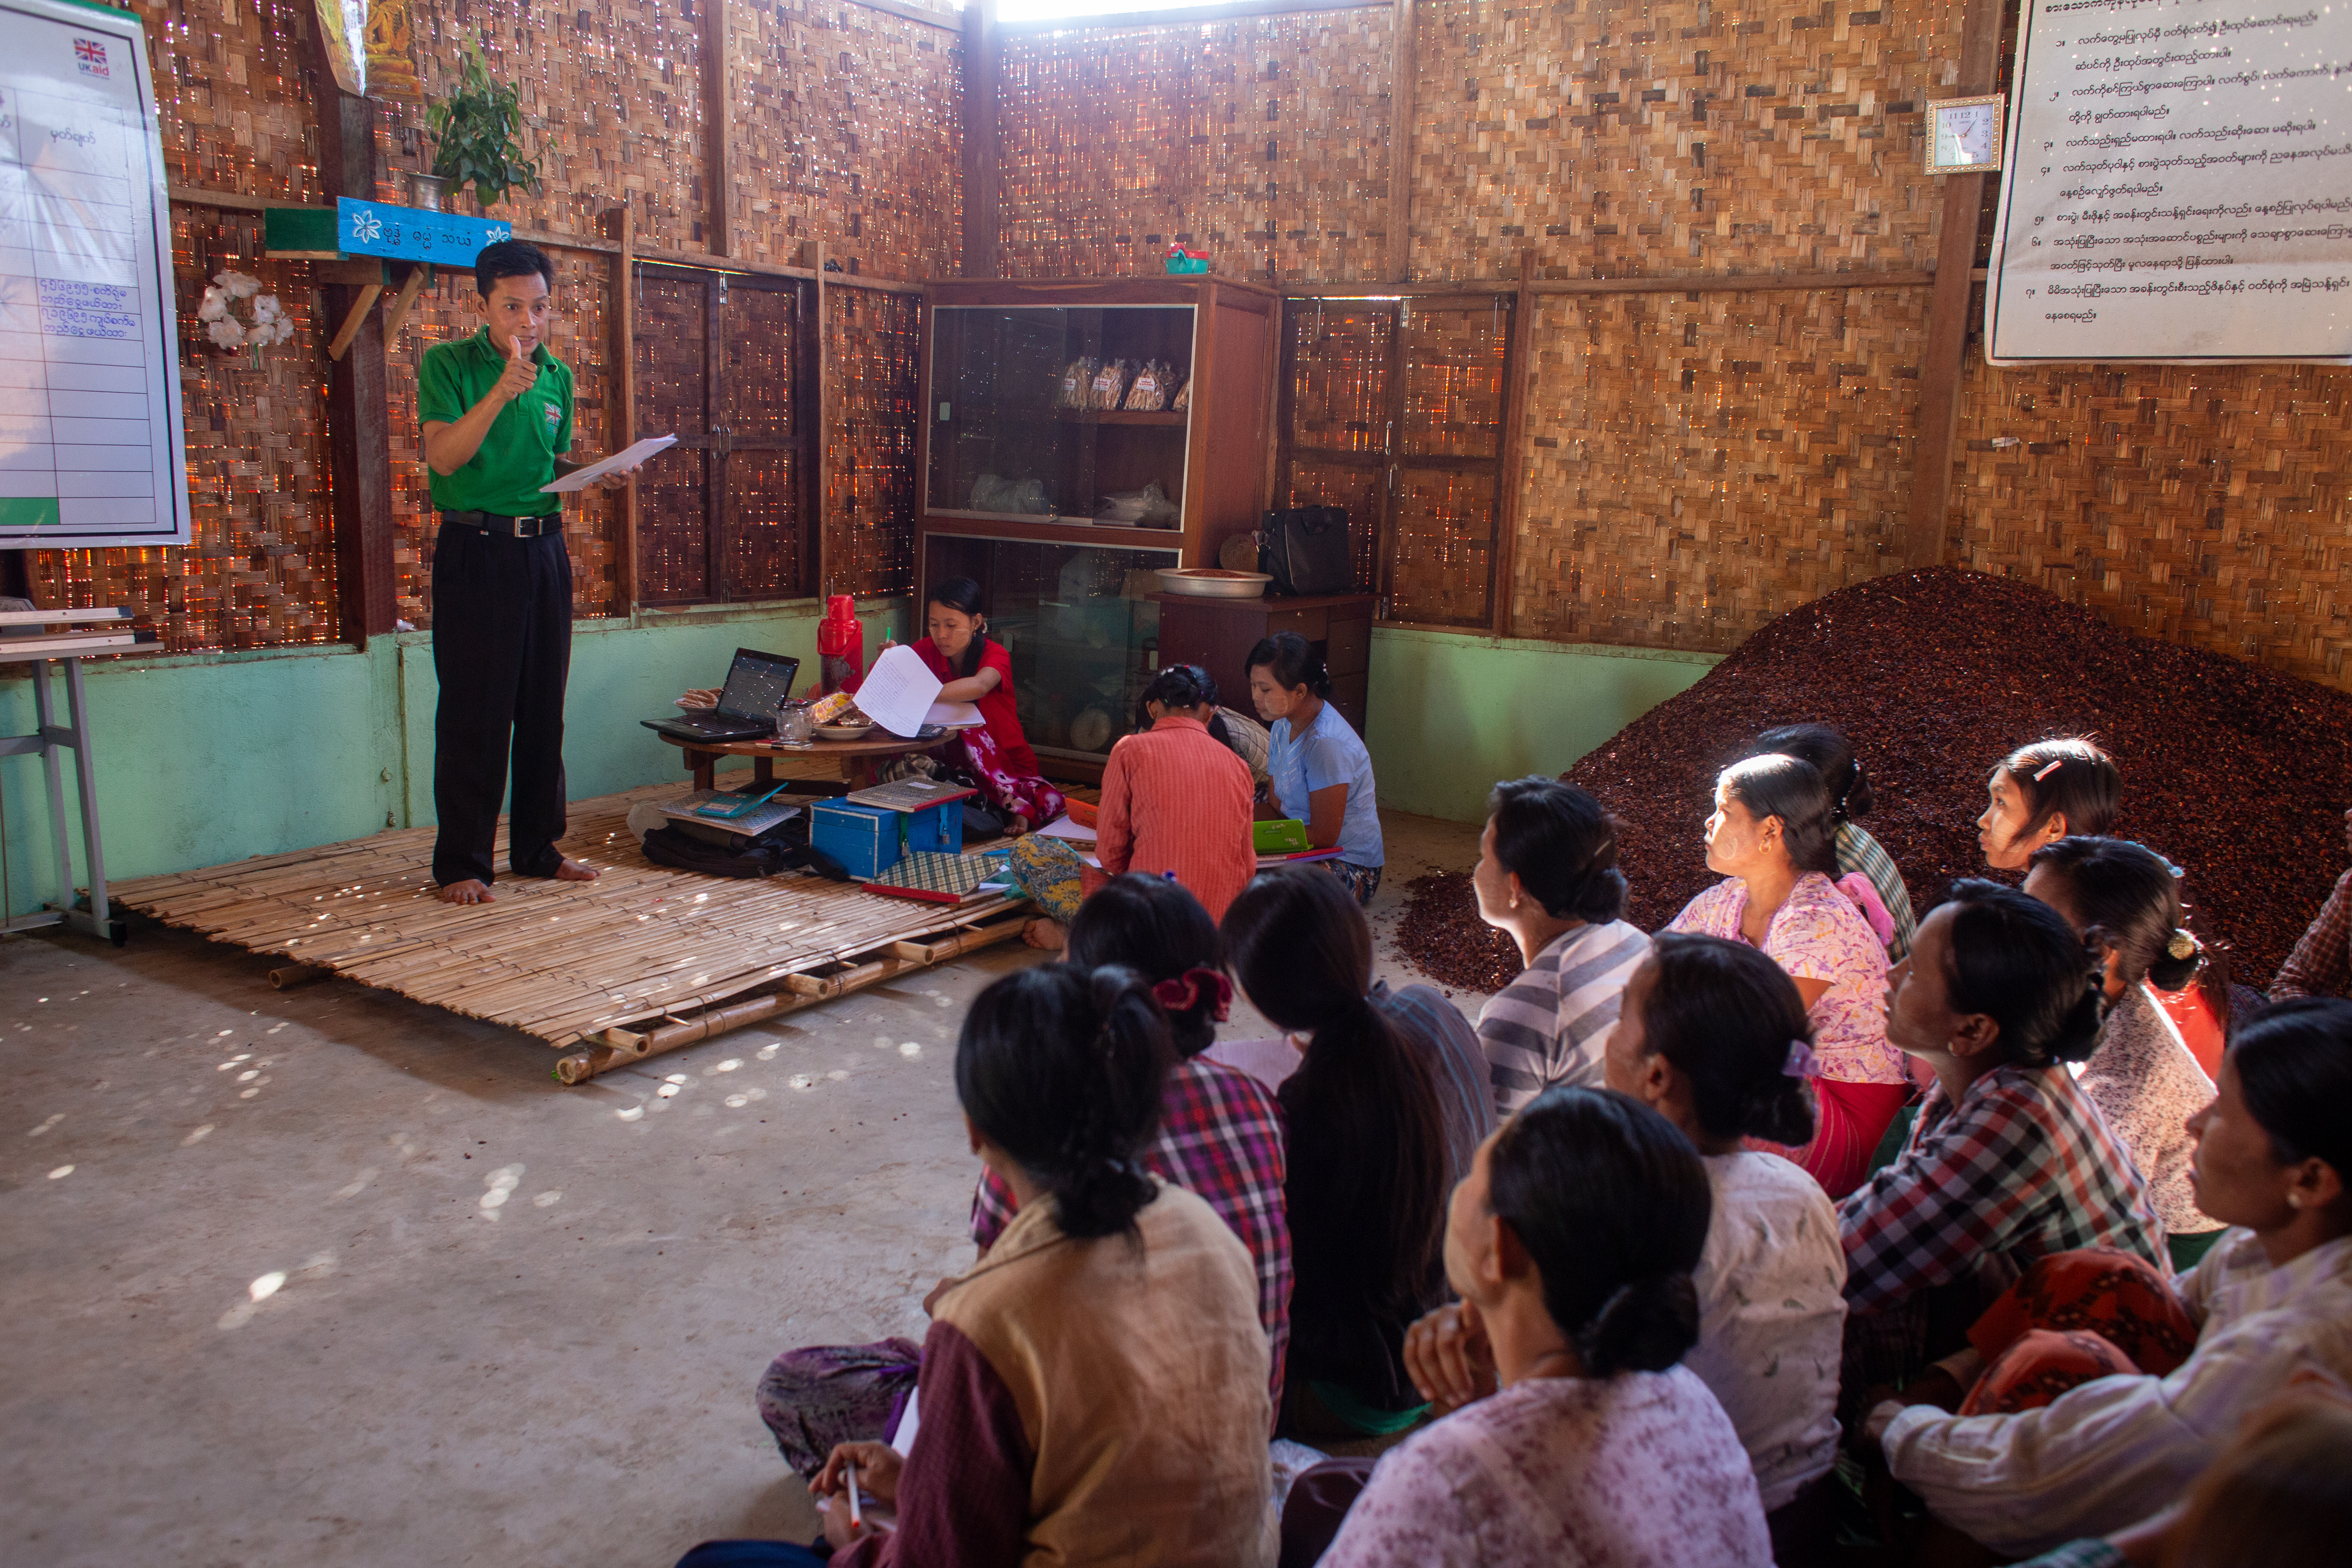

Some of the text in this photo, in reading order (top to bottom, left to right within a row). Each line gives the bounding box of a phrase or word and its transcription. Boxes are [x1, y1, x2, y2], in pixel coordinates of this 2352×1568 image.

[2075, 46, 2231, 72] ဆံပင်ကို ဦးထုပ်အတွင်းထည့်ထားပါ။
[2049, 92, 2059, 102] ၂။
[2072, 75, 2215, 98] လက်ကိုစင်ကြယ်စွာဆေးကြောပါ။
[2069, 105, 2170, 125] တို့ကို ချွတ်ထားရပါမည်။
[51, 127, 96, 147] မှတ်ချက်
[2044, 142, 2053, 152] ၃။
[2066, 130, 2176, 149] လက်သည်းရှည်မထားရပါ။
[2040, 167, 2050, 176] ၄။
[2063, 158, 2135, 174] လက်သုတ်ပုဝါနှင့်
[2138, 149, 2267, 169] စားပွဲသုတ်သည့်အဝတ်များကို
[2034, 216, 2044, 226] ၅။
[2032, 237, 2042, 246] ၆။
[2053, 235, 2120, 249] အသုံးပြုပြီးသော
[2026, 289, 2035, 299] ၇။
[2248, 278, 2287, 293] ဝတ်စုံကို
[2045, 309, 2097, 323] နေစေရမည်။
